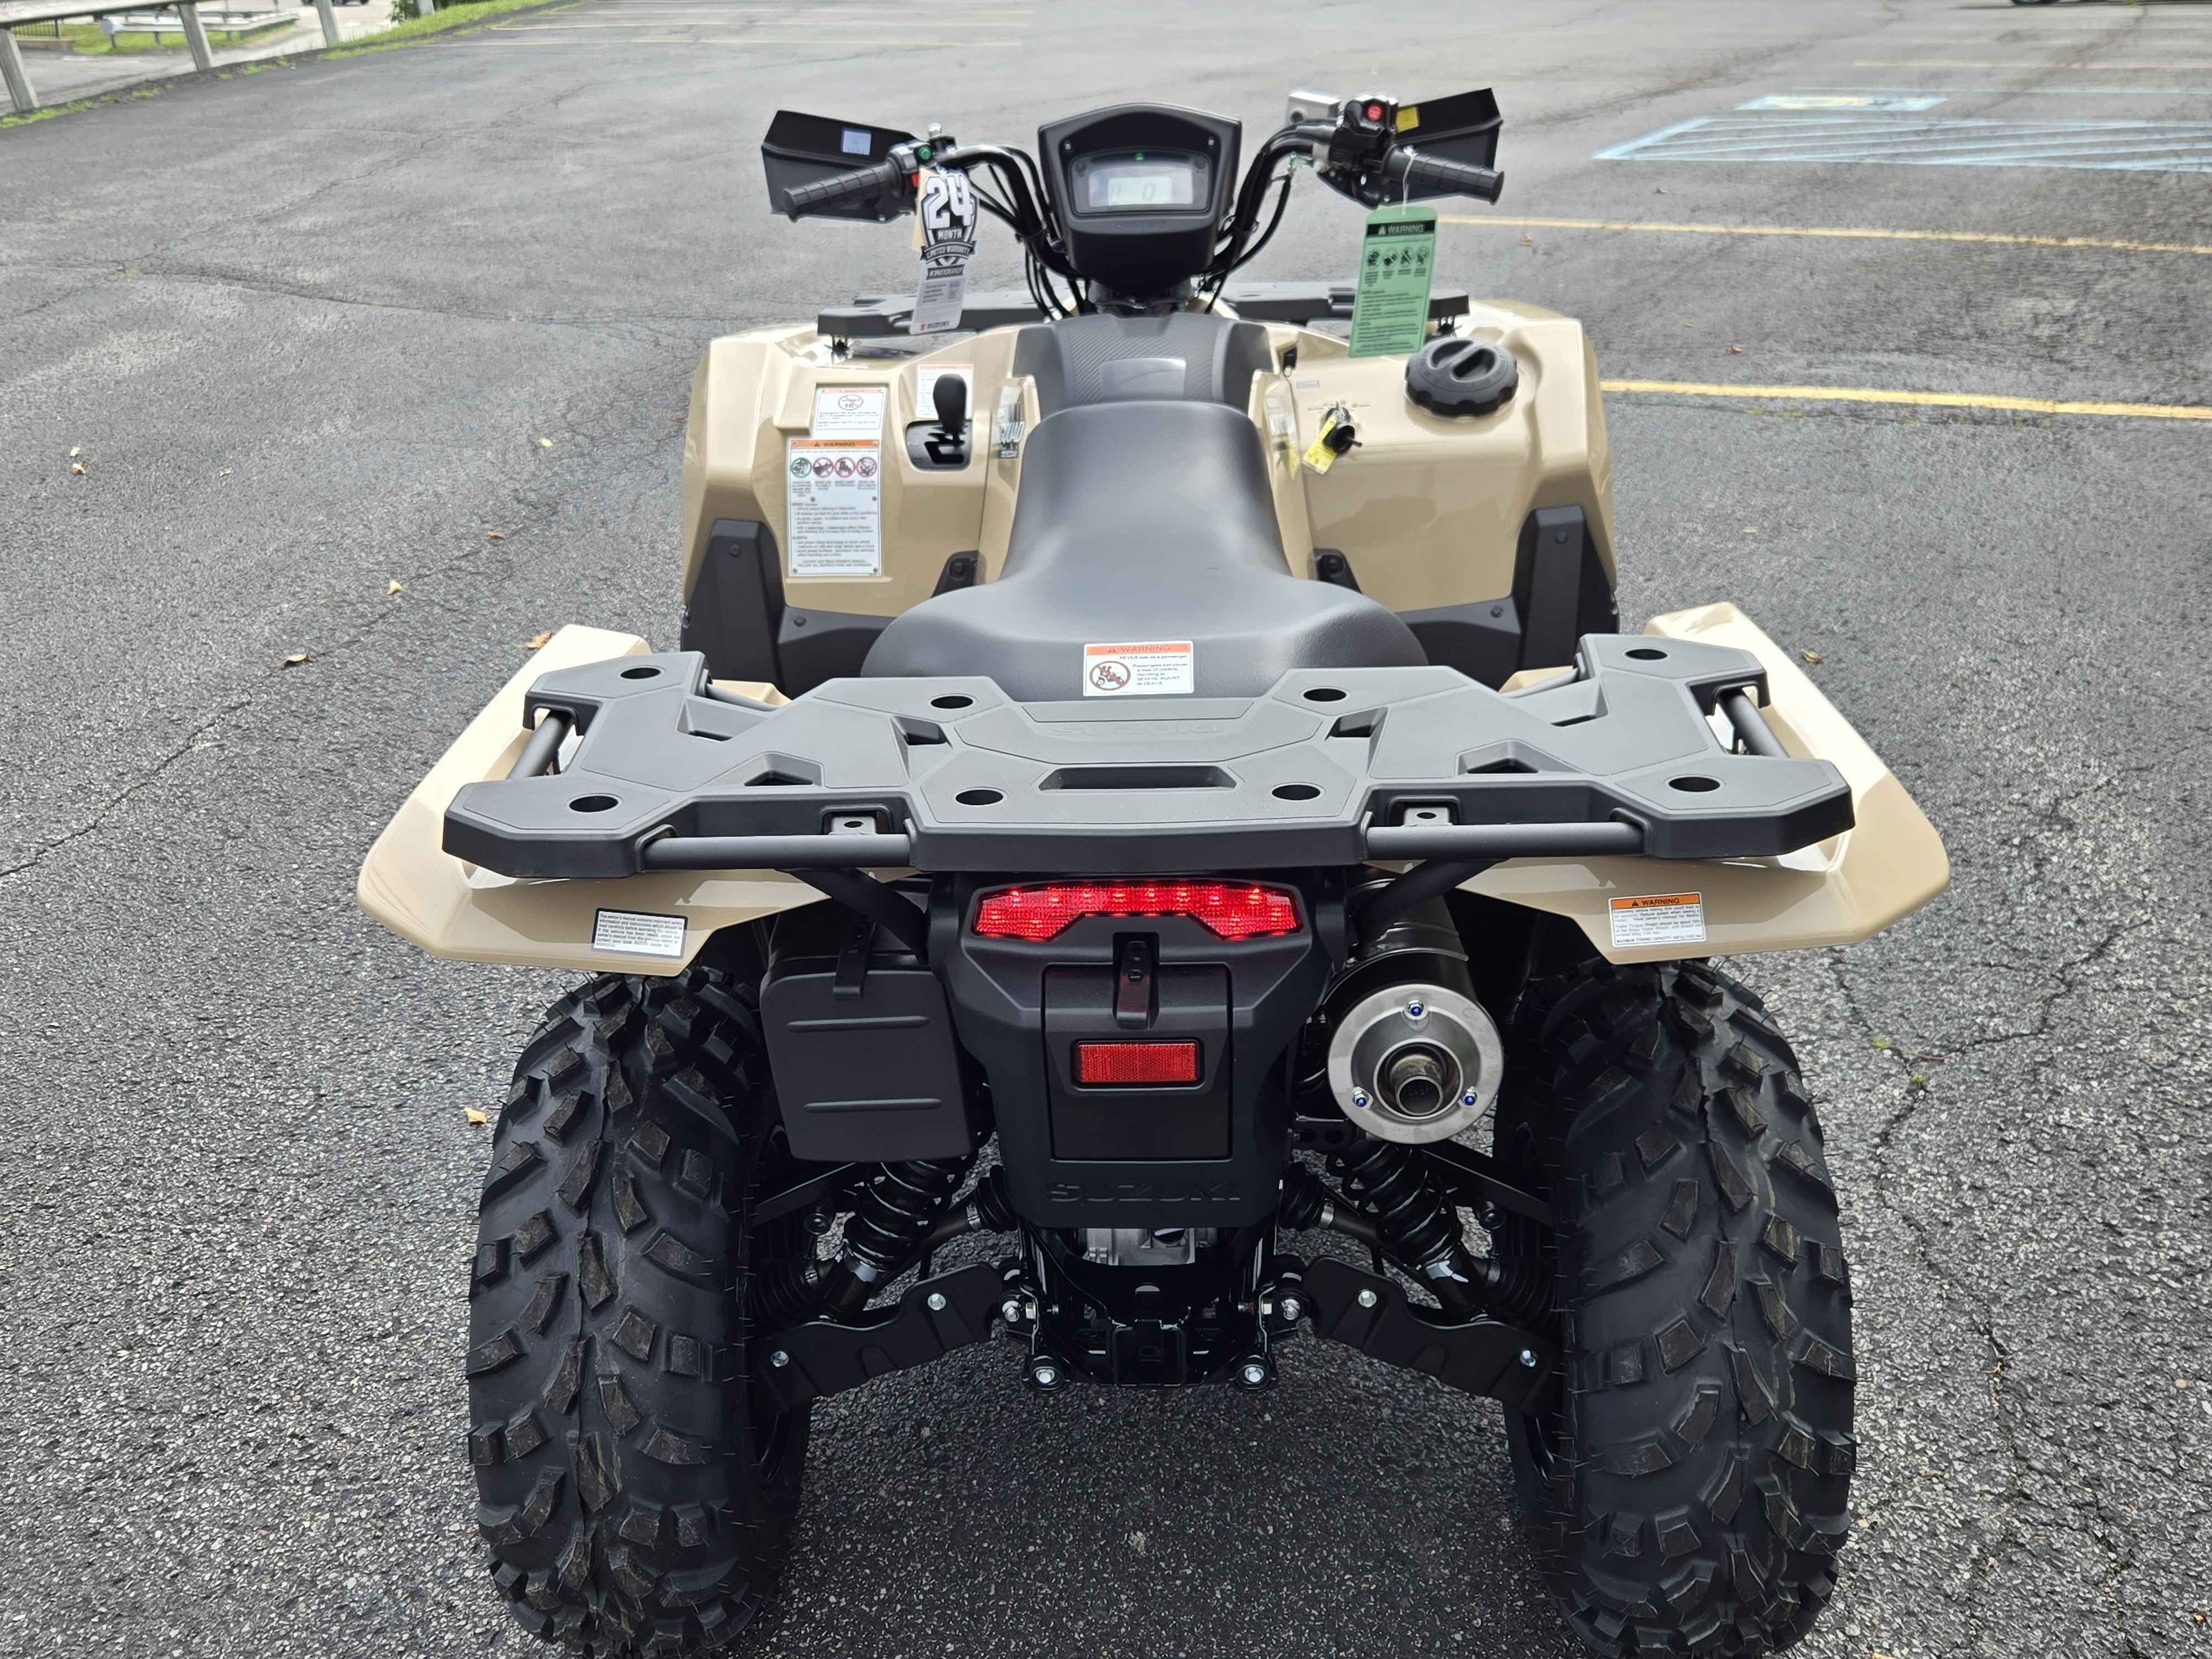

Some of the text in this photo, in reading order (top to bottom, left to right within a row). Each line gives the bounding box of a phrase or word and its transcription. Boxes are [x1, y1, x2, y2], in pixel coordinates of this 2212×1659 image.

[1141, 183, 1156, 201] 0
[926, 174, 973, 229] 24
[937, 228, 963, 241] MONTH
[1387, 224, 1425, 234] WARNING
[927, 246, 971, 259] LIMITED WARRANTY
[929, 267, 963, 276] KINGQUAD
[1641, 898, 1679, 906] WARNING
[1045, 1182, 1243, 1202] SUZUKI
